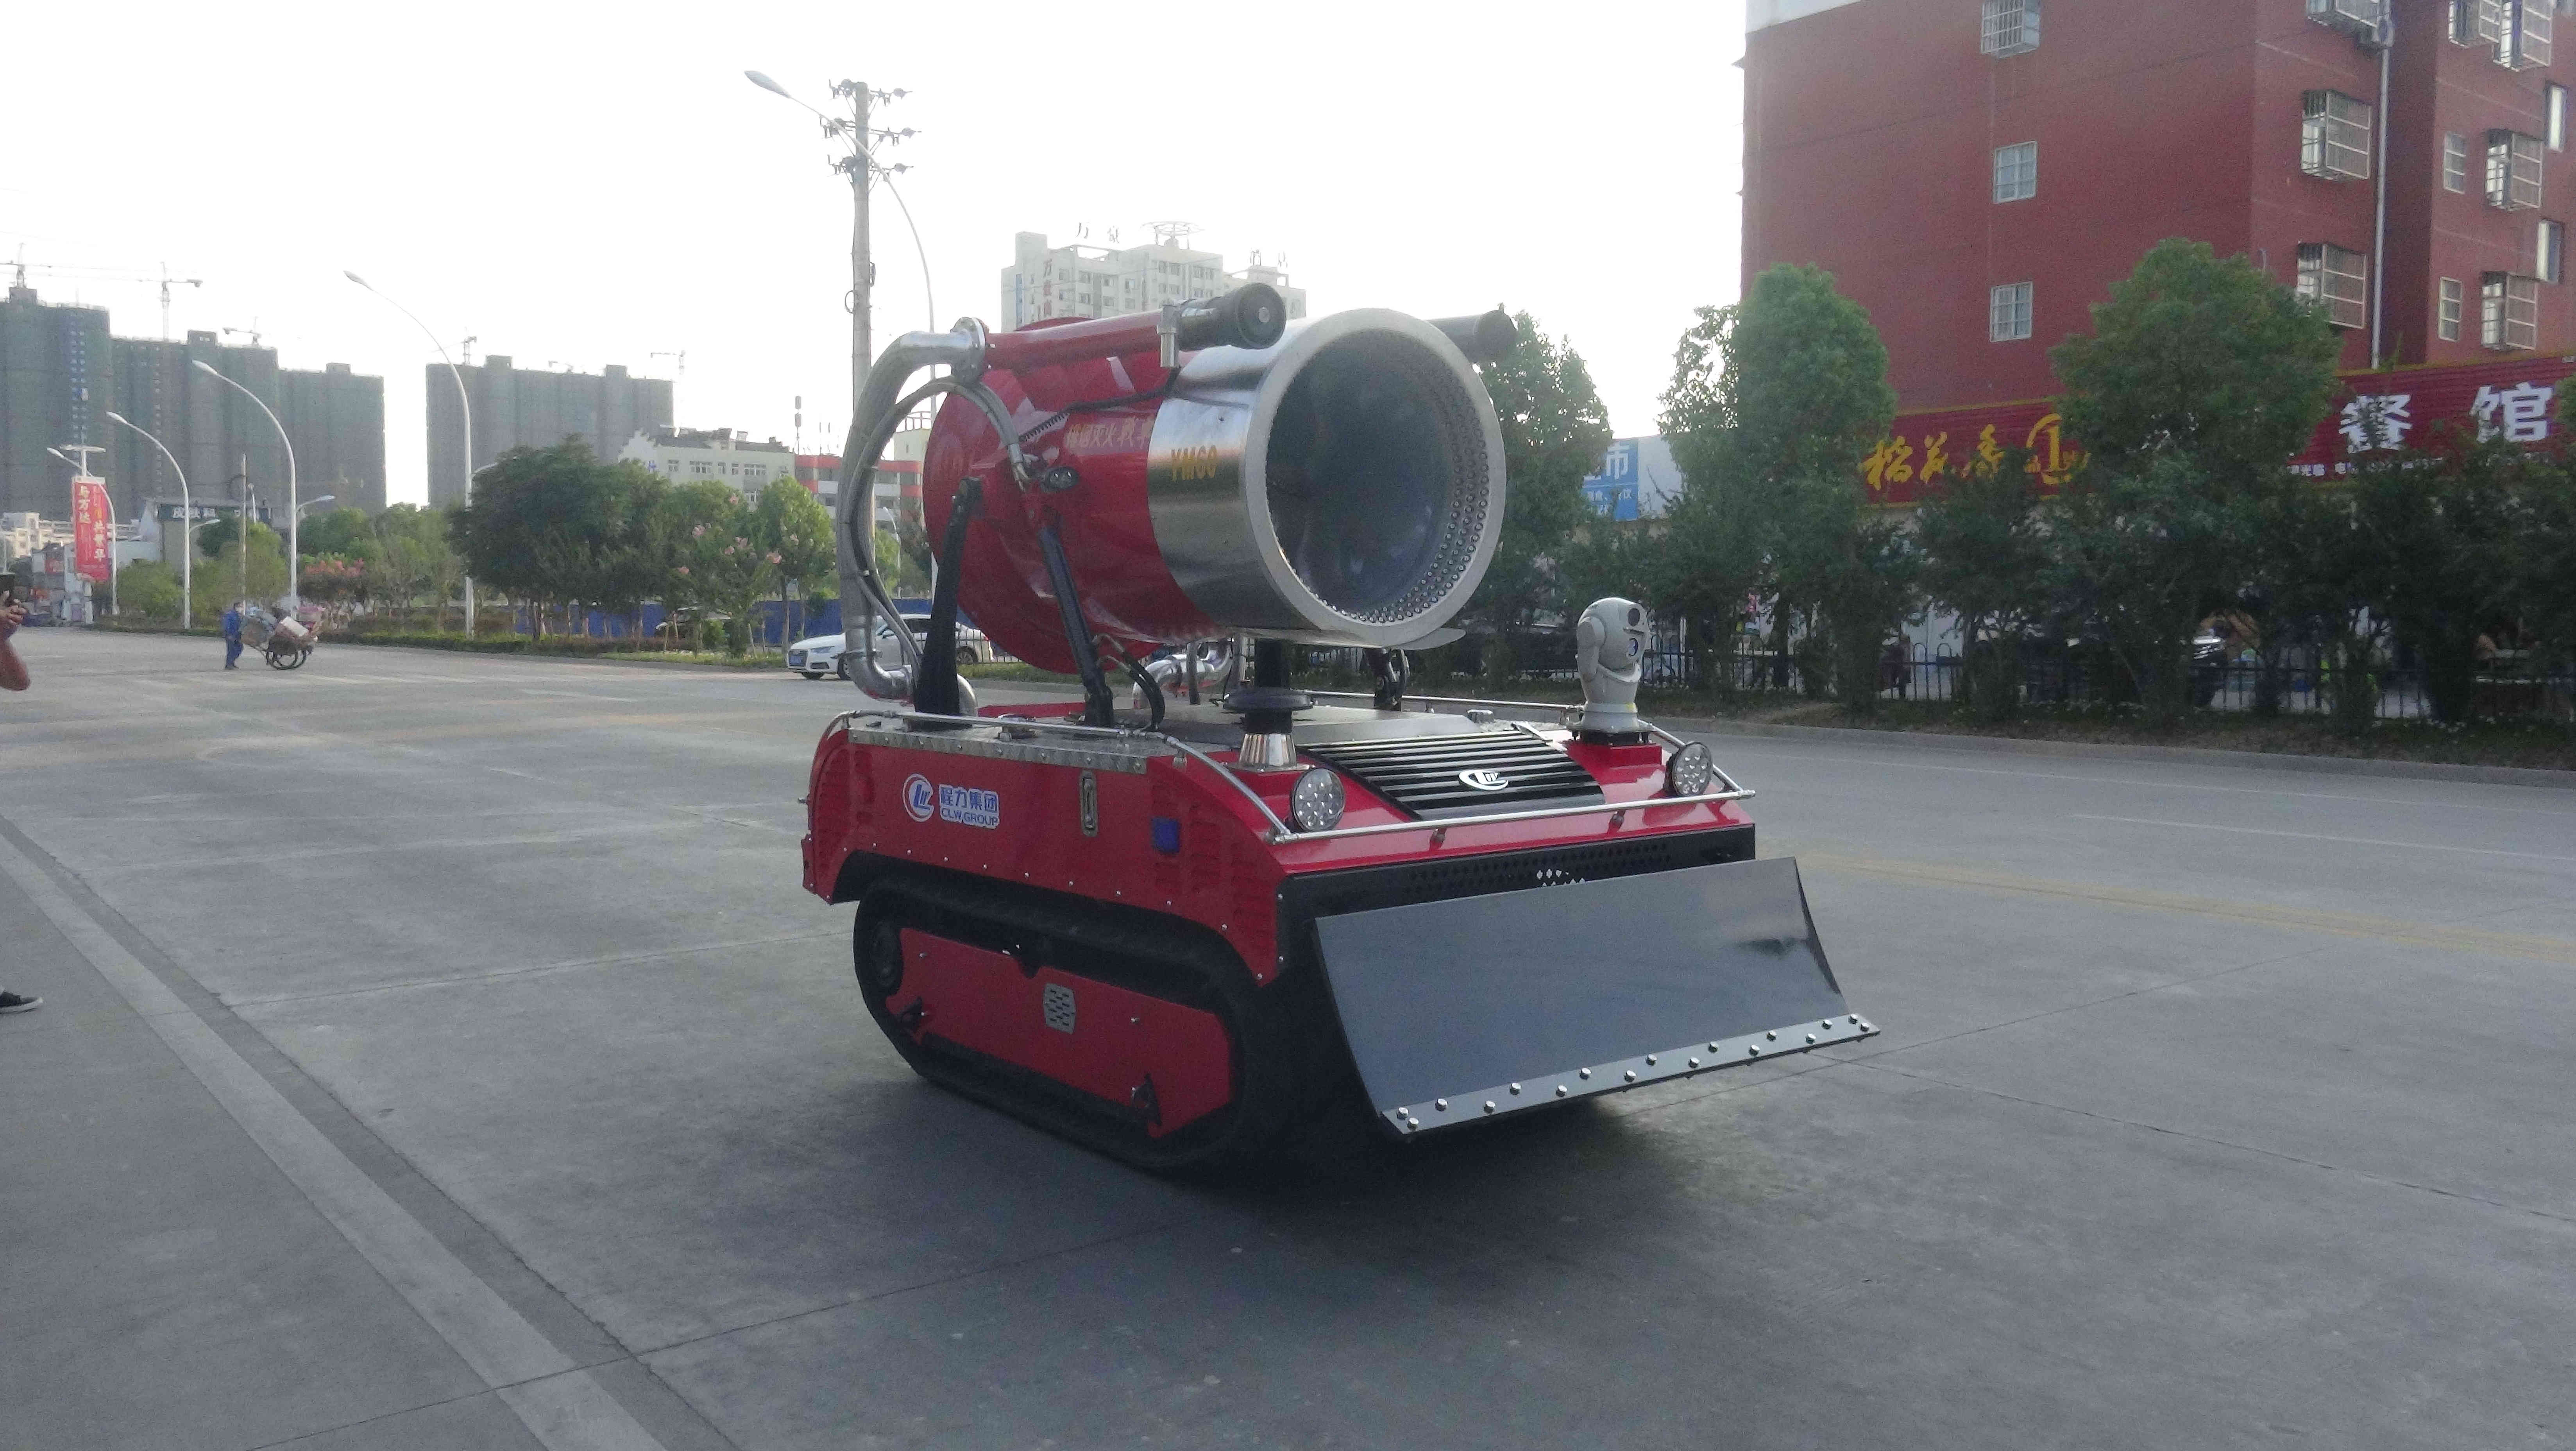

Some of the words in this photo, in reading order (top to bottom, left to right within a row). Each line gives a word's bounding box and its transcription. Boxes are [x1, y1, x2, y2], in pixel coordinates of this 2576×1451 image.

[940, 786, 997, 813] 程力集团
[941, 807, 962, 820] CLW
[964, 811, 999, 826] GROUP
